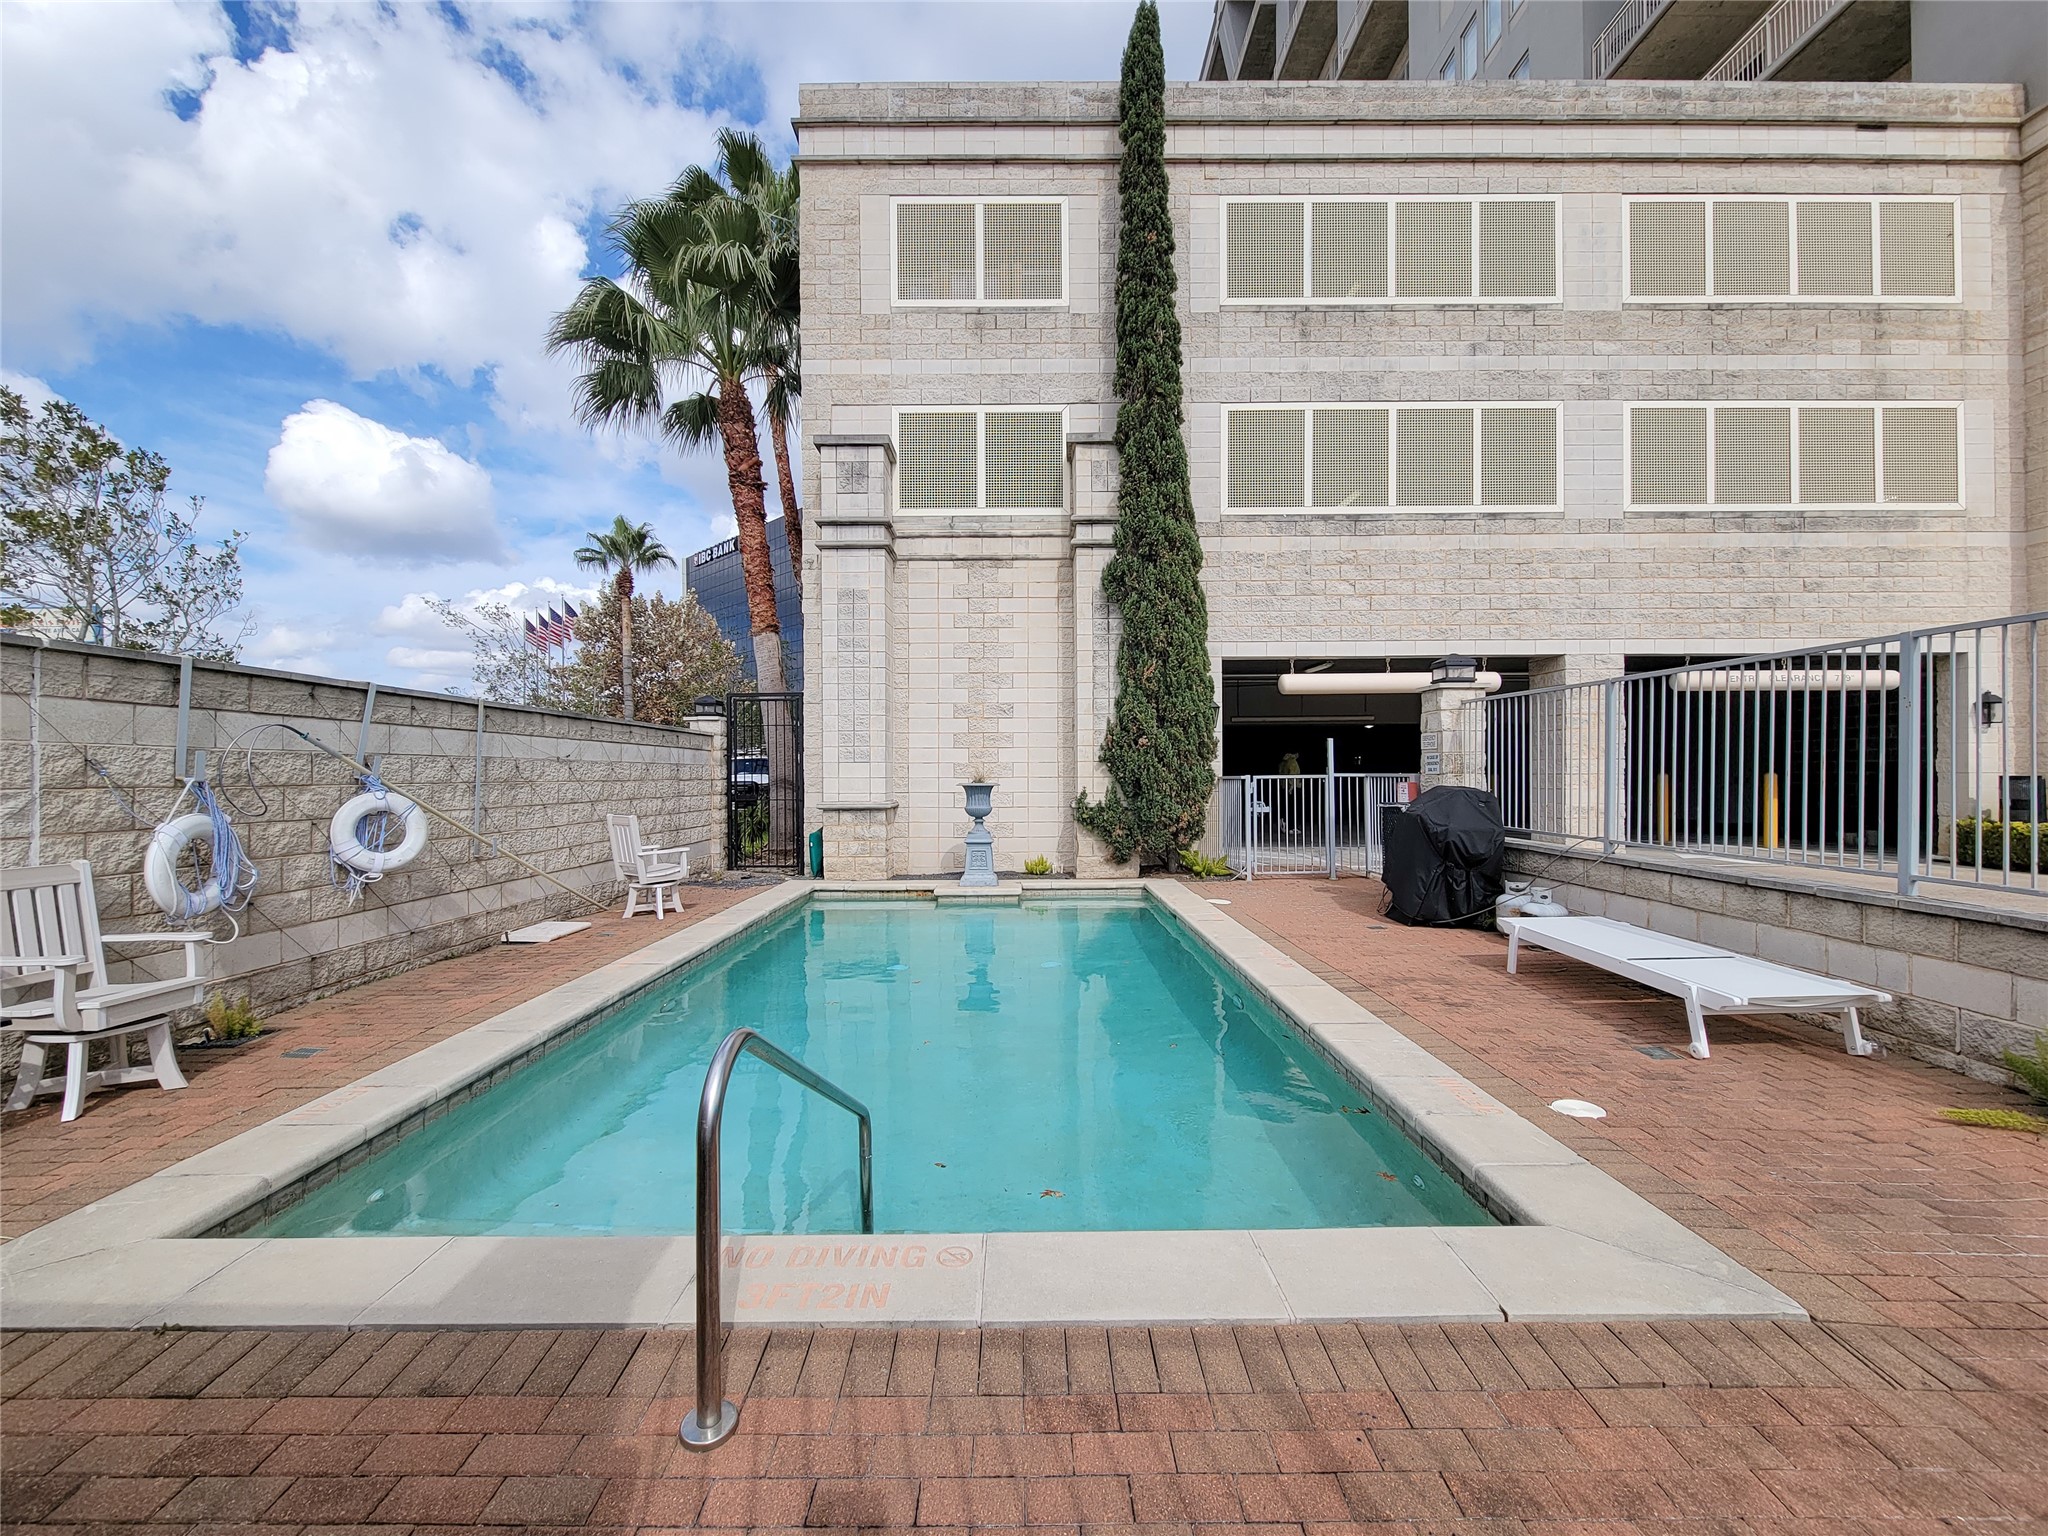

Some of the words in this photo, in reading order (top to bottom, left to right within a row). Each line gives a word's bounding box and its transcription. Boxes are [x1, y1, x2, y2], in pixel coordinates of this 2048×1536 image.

[698, 549, 711, 565] IBC
[712, 539, 735, 559] BANK
[1730, 675, 1758, 683] ENTR
[721, 1245, 776, 1269] NO
[785, 1245, 928, 1269] DIVING
[738, 1282, 891, 1310] 3FT2IN
